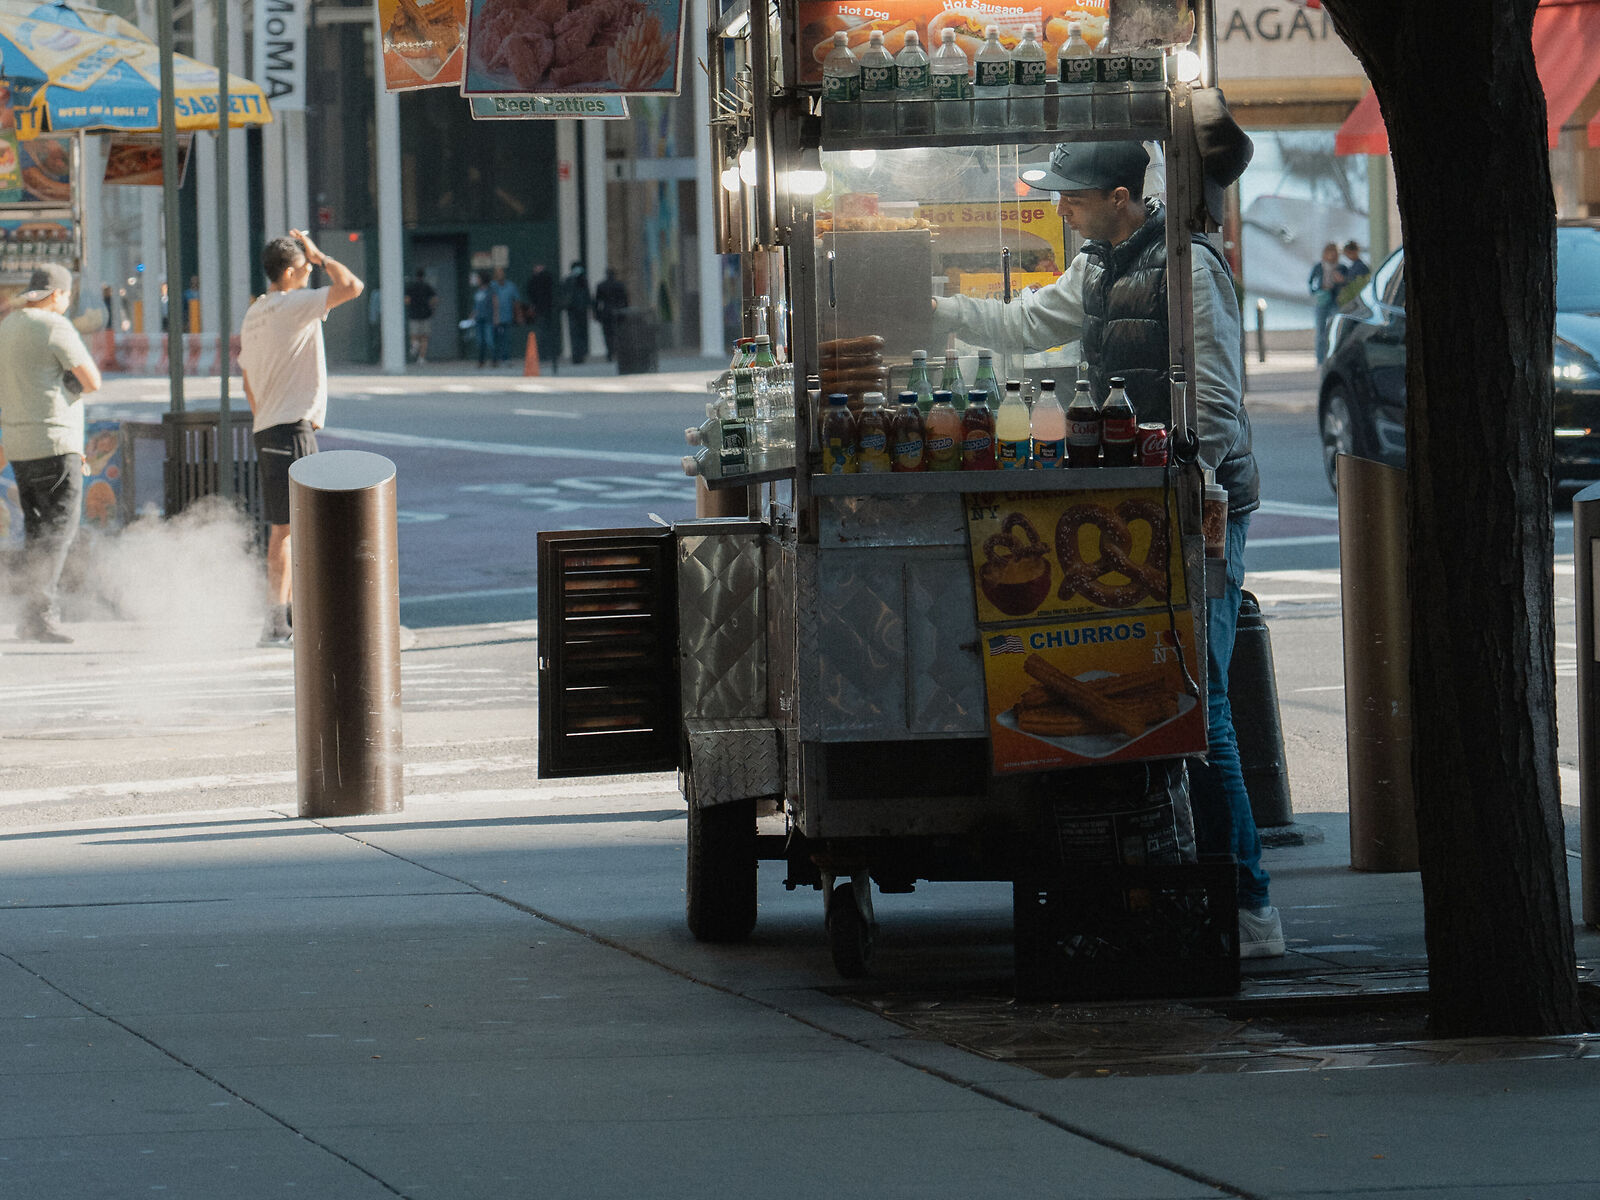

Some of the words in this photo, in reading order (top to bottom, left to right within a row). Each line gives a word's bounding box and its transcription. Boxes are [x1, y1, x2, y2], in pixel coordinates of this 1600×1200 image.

[838, 5, 861, 16] Hot
[864, 8, 890, 20] Dog
[942, 0, 970, 11] Hot
[971, 1, 1024, 16] Sausage
[982, 62, 1007, 75] 100
[1022, 62, 1046, 75] 100
[1067, 60, 1091, 73] 100
[1103, 58, 1128, 72] 100
[1131, 59, 1155, 71] 100
[113, 106, 136, 117] ROLL
[175, 93, 263, 117] SABETT
[495, 97, 538, 113] Beef
[544, 97, 606, 113] Patties
[920, 208, 955, 223] Hot
[962, 208, 1045, 224] Sausage
[970, 504, 1000, 521] NY
[1029, 622, 1146, 649] CHURROS
